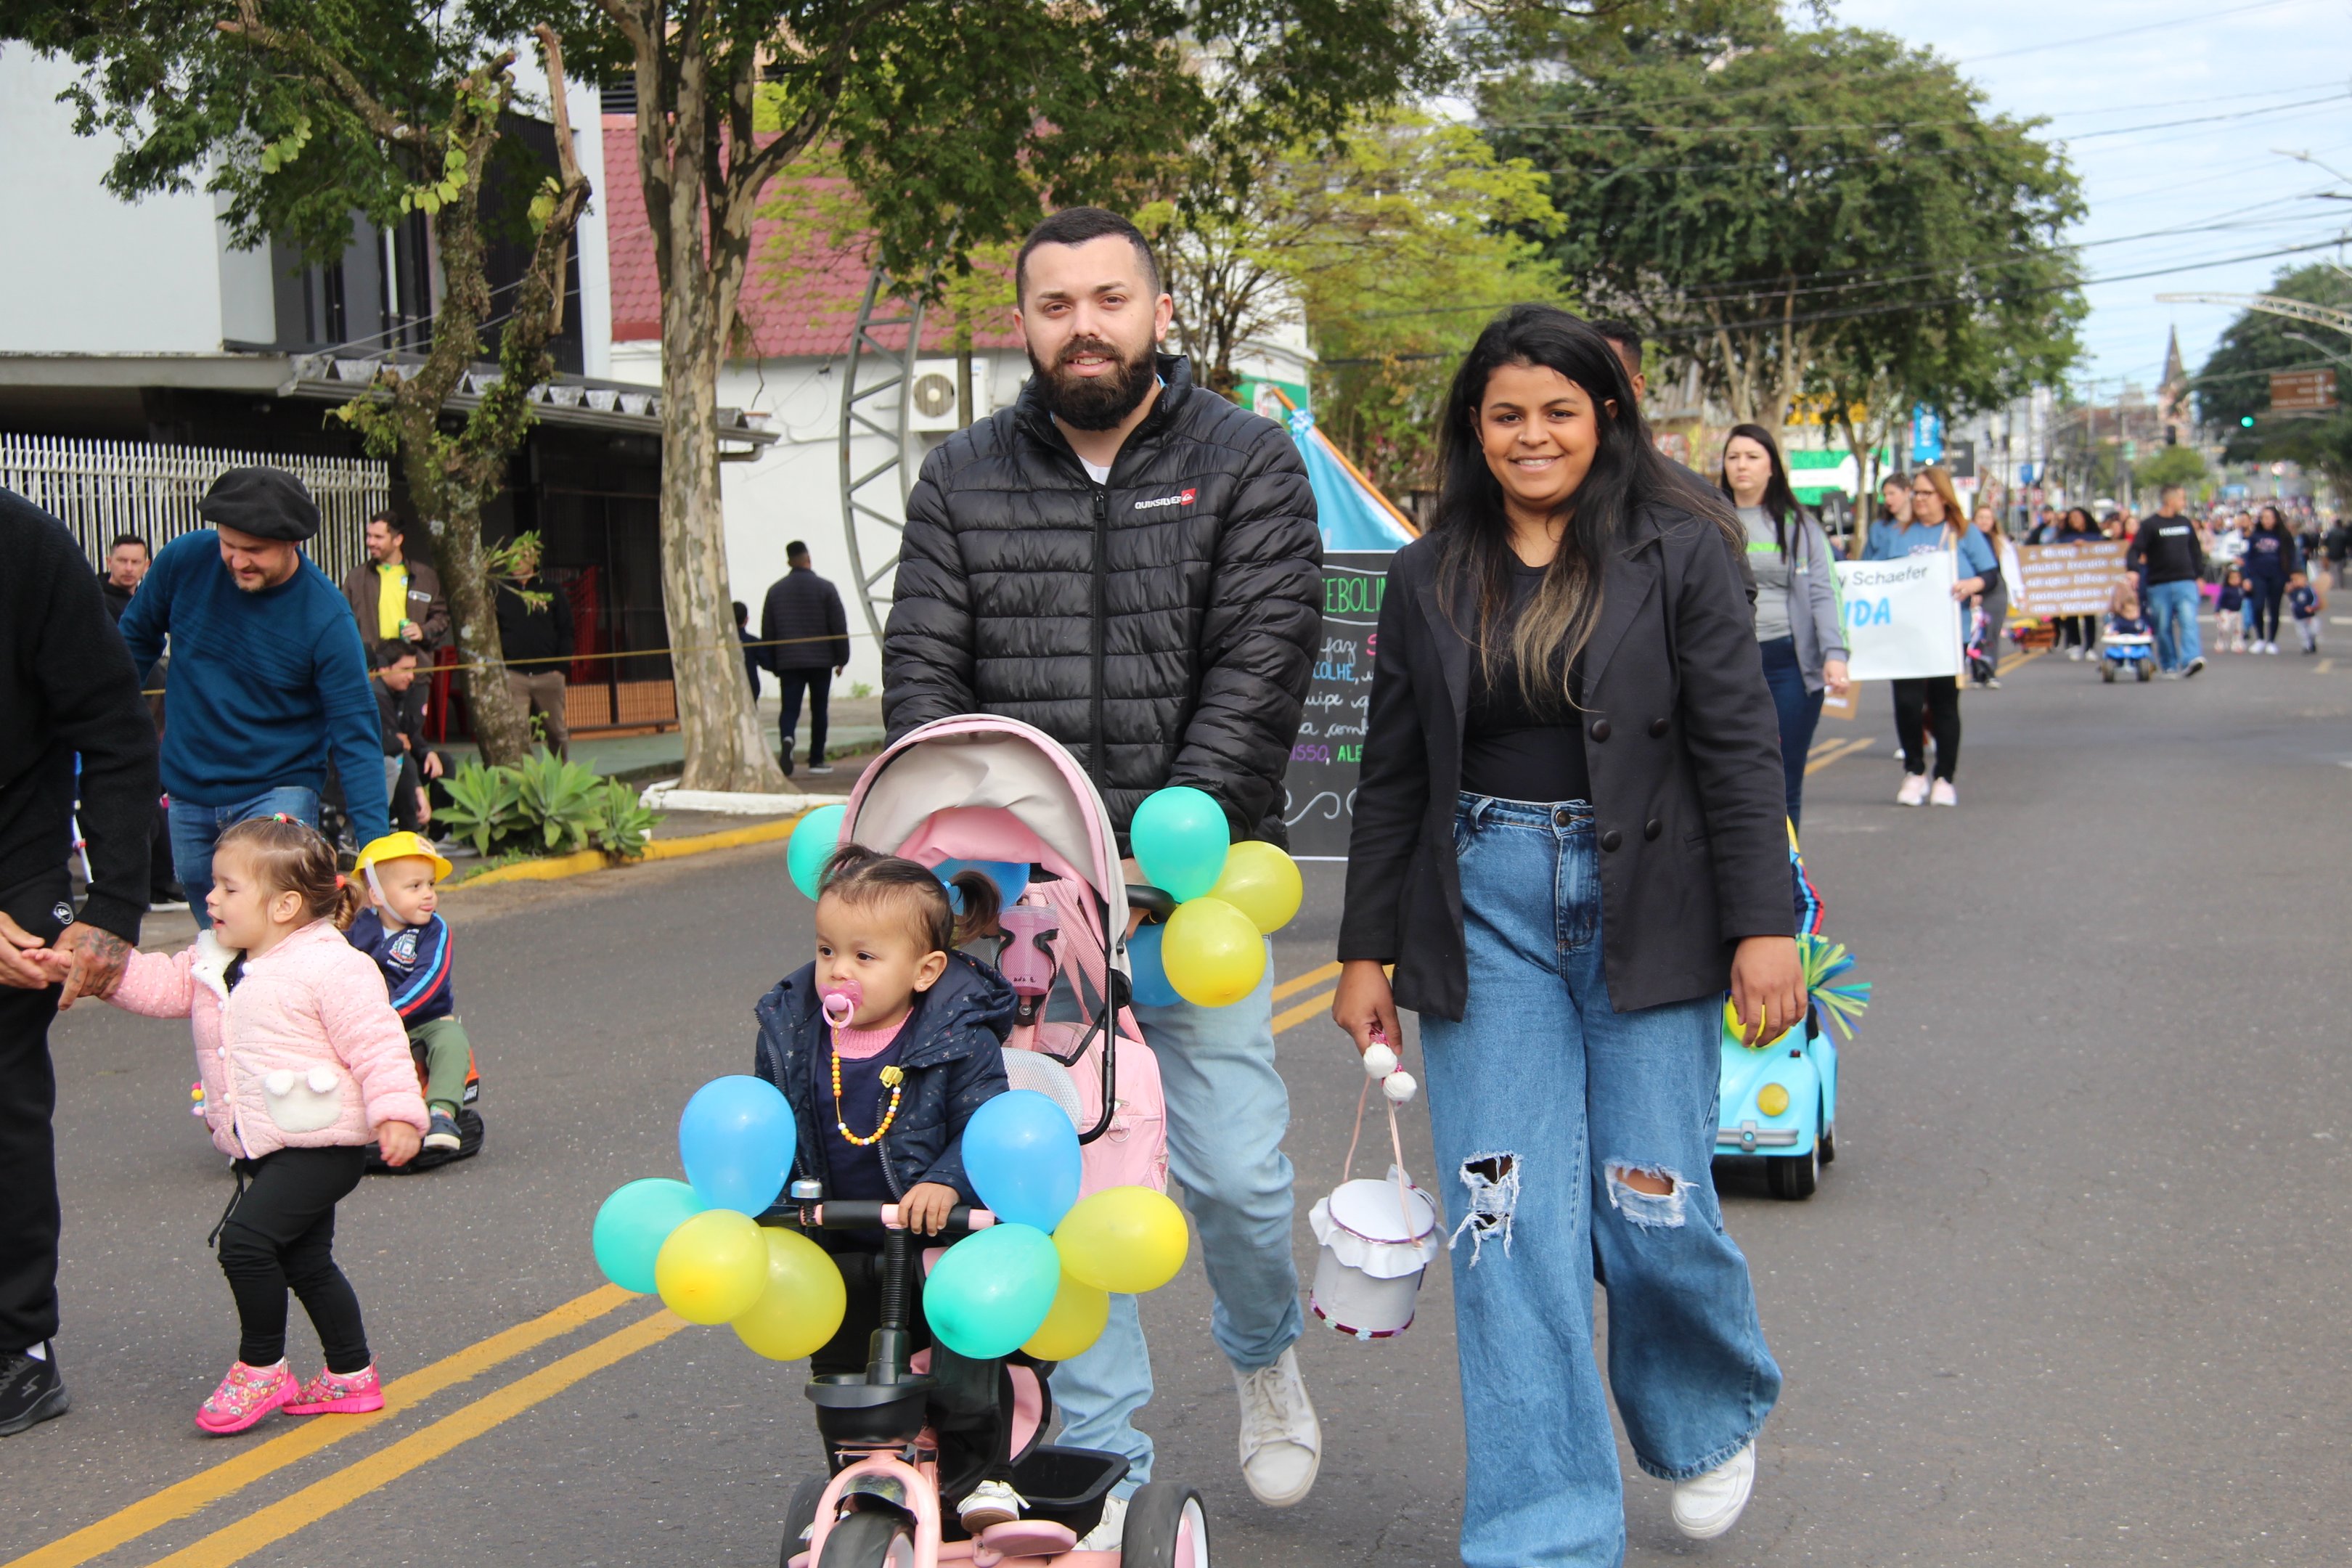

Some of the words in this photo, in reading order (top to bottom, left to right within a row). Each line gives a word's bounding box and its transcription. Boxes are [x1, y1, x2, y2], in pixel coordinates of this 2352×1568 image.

[1134, 495, 1182, 510] QUIKSILVER
[1852, 565, 1928, 587] Schaefer
[1322, 577, 1386, 613] EBOLI
